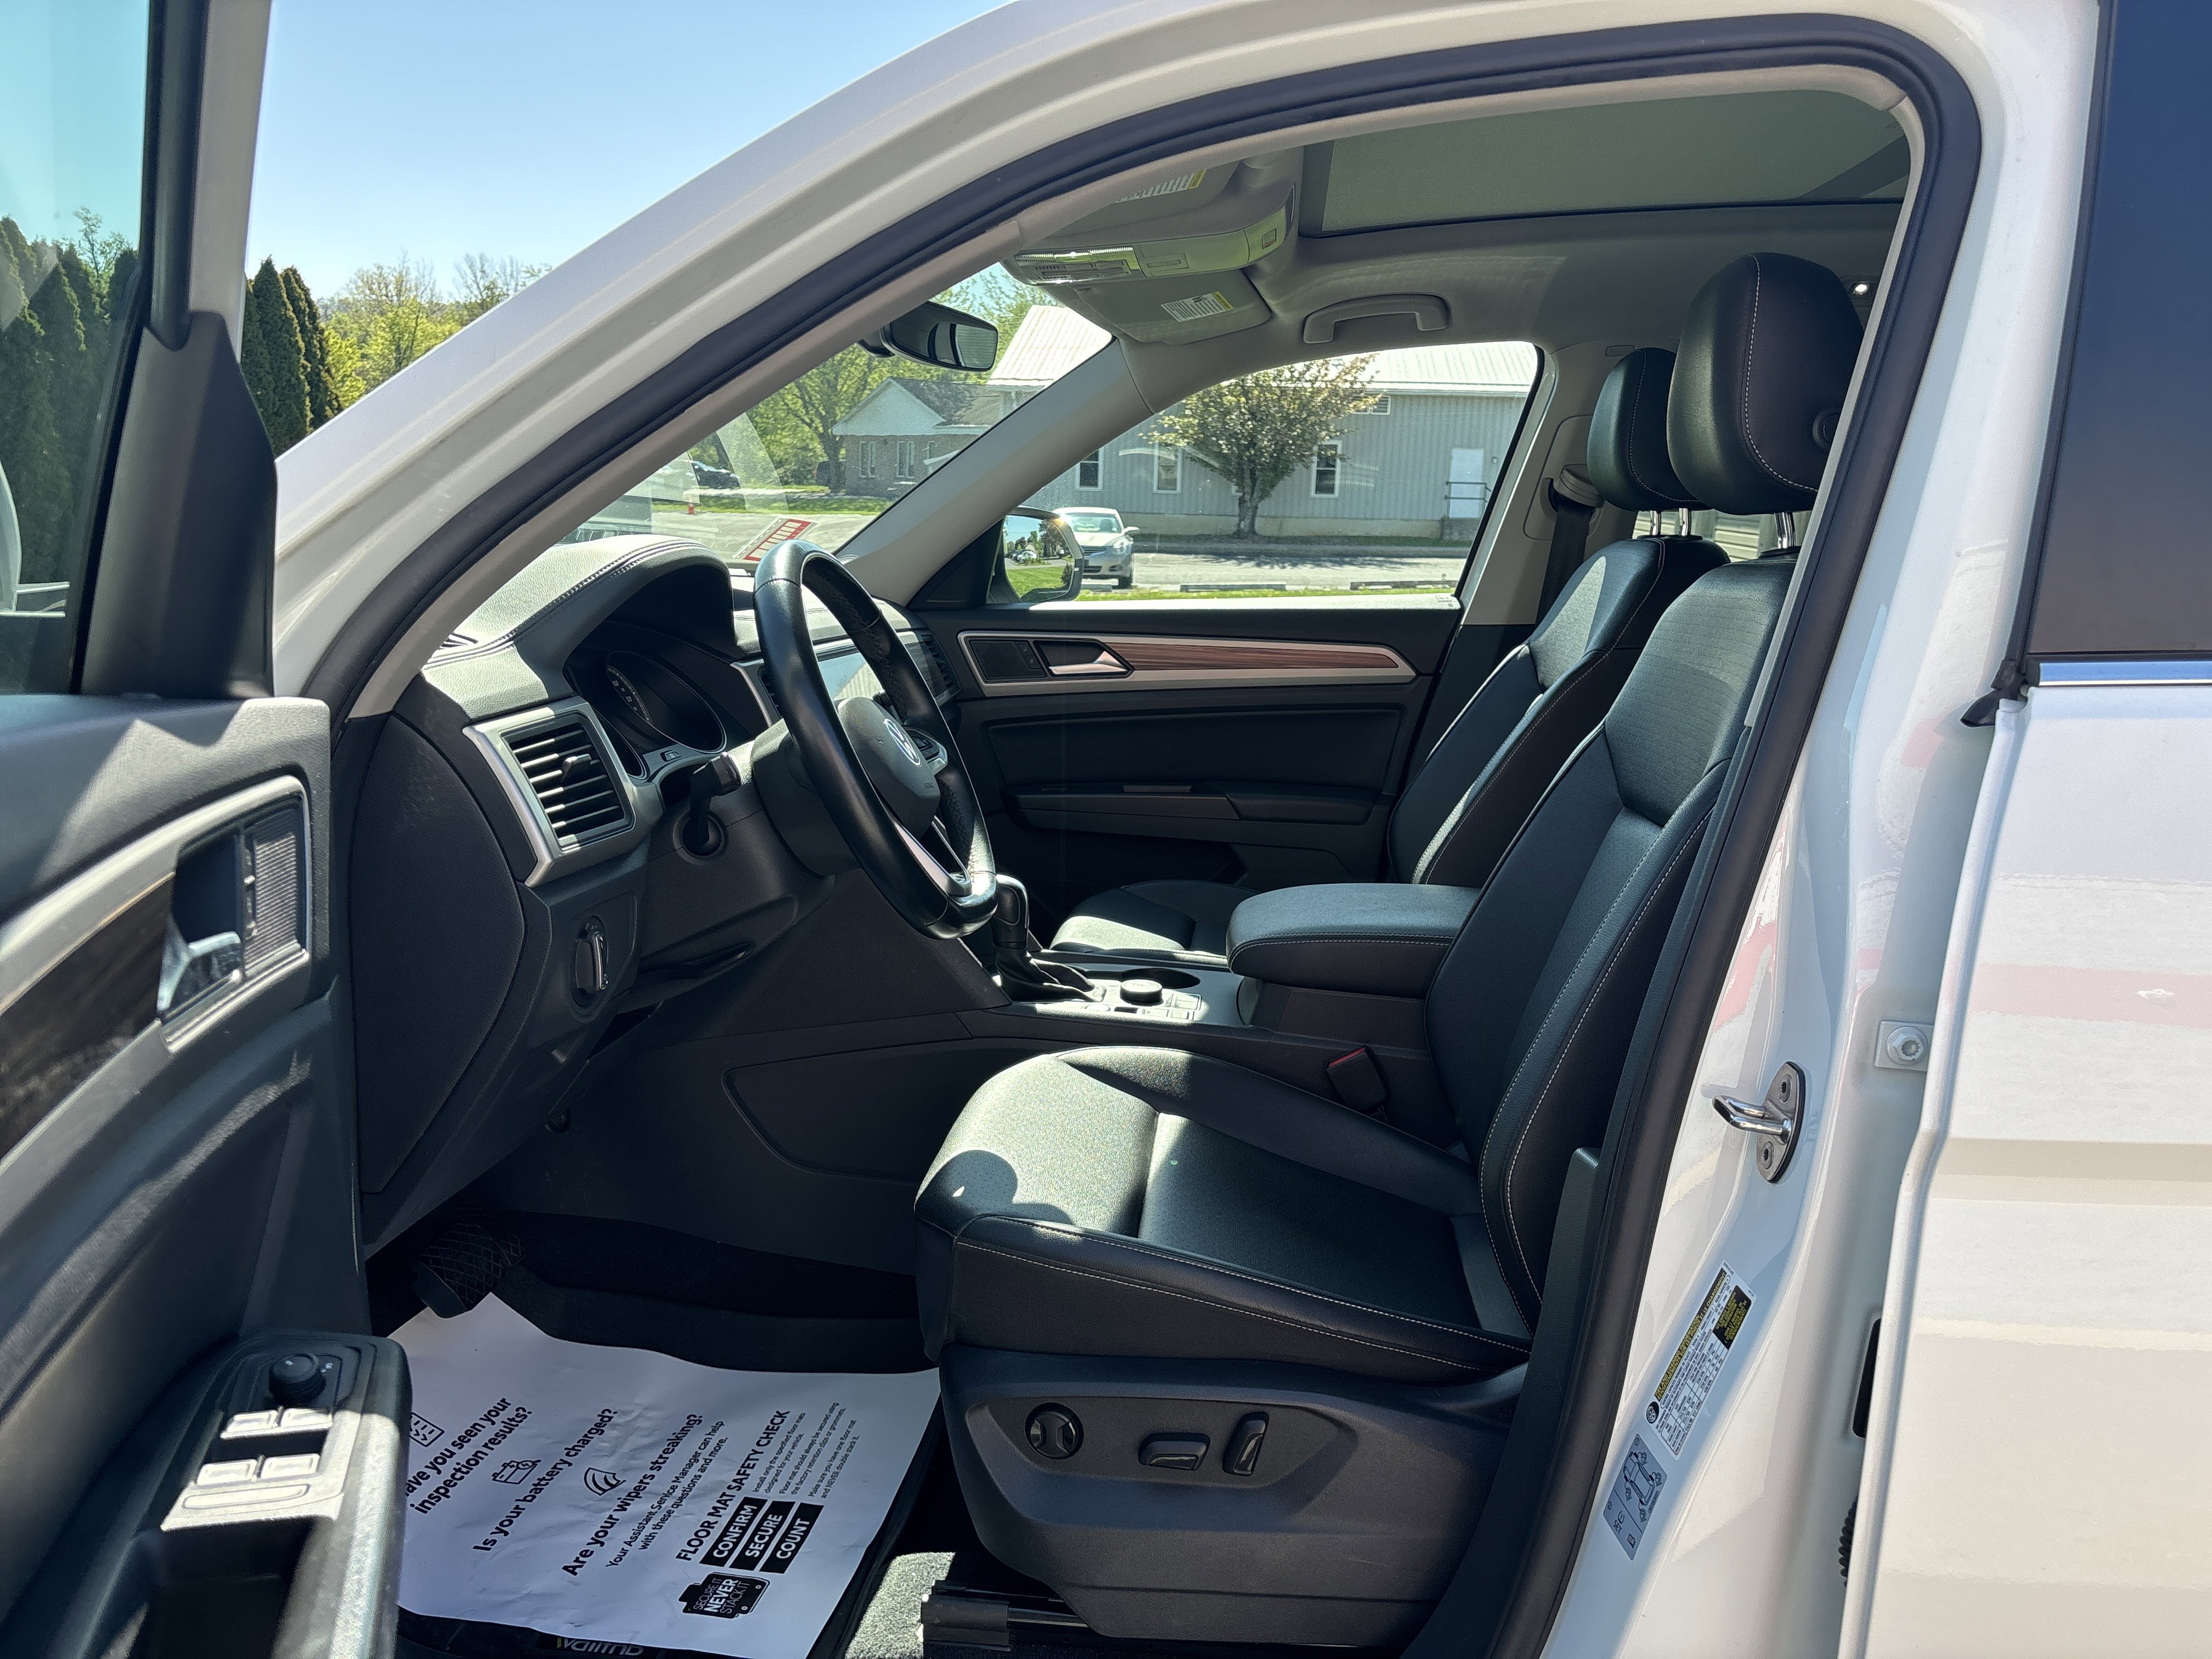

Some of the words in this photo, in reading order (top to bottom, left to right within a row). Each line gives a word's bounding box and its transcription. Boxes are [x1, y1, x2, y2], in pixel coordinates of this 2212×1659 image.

[405, 1470, 431, 1497] ave
[425, 1447, 457, 1475] you
[450, 1422, 487, 1450] seen
[479, 1397, 512, 1426] your
[698, 1437, 712, 1450] can
[704, 1421, 725, 1436] help
[409, 1450, 489, 1514] inspection
[482, 1406, 533, 1451] results?
[472, 1538, 498, 1551] Is
[489, 1504, 526, 1537] your
[515, 1458, 573, 1503] battery
[563, 1408, 618, 1458] charged?
[672, 1451, 702, 1483] Manager
[561, 1548, 595, 1576] Are
[586, 1514, 620, 1548] your
[613, 1473, 656, 1513] wipers
[649, 1413, 703, 1472] streaking?
[639, 1532, 658, 1550] with
[651, 1509, 675, 1530] these
[671, 1474, 702, 1509] questions
[698, 1458, 713, 1473] and
[708, 1437, 729, 1457] more.
[651, 1485, 679, 1510] Service
[675, 1520, 719, 1561] FLOOR
[707, 1491, 736, 1518] MAT
[726, 1448, 765, 1491] SAFETY
[755, 1409, 791, 1447] CHECK
[623, 1510, 658, 1547] Assistant
[713, 1505, 758, 1558] CONFIRM
[745, 1514, 783, 1558] SECURE
[776, 1518, 811, 1559] COUNT
[606, 1547, 629, 1567] Your
[693, 1584, 719, 1610] SECURE
[703, 1579, 739, 1612] NEVER
[719, 1588, 747, 1614] STACK
[737, 1581, 750, 1589] IT
